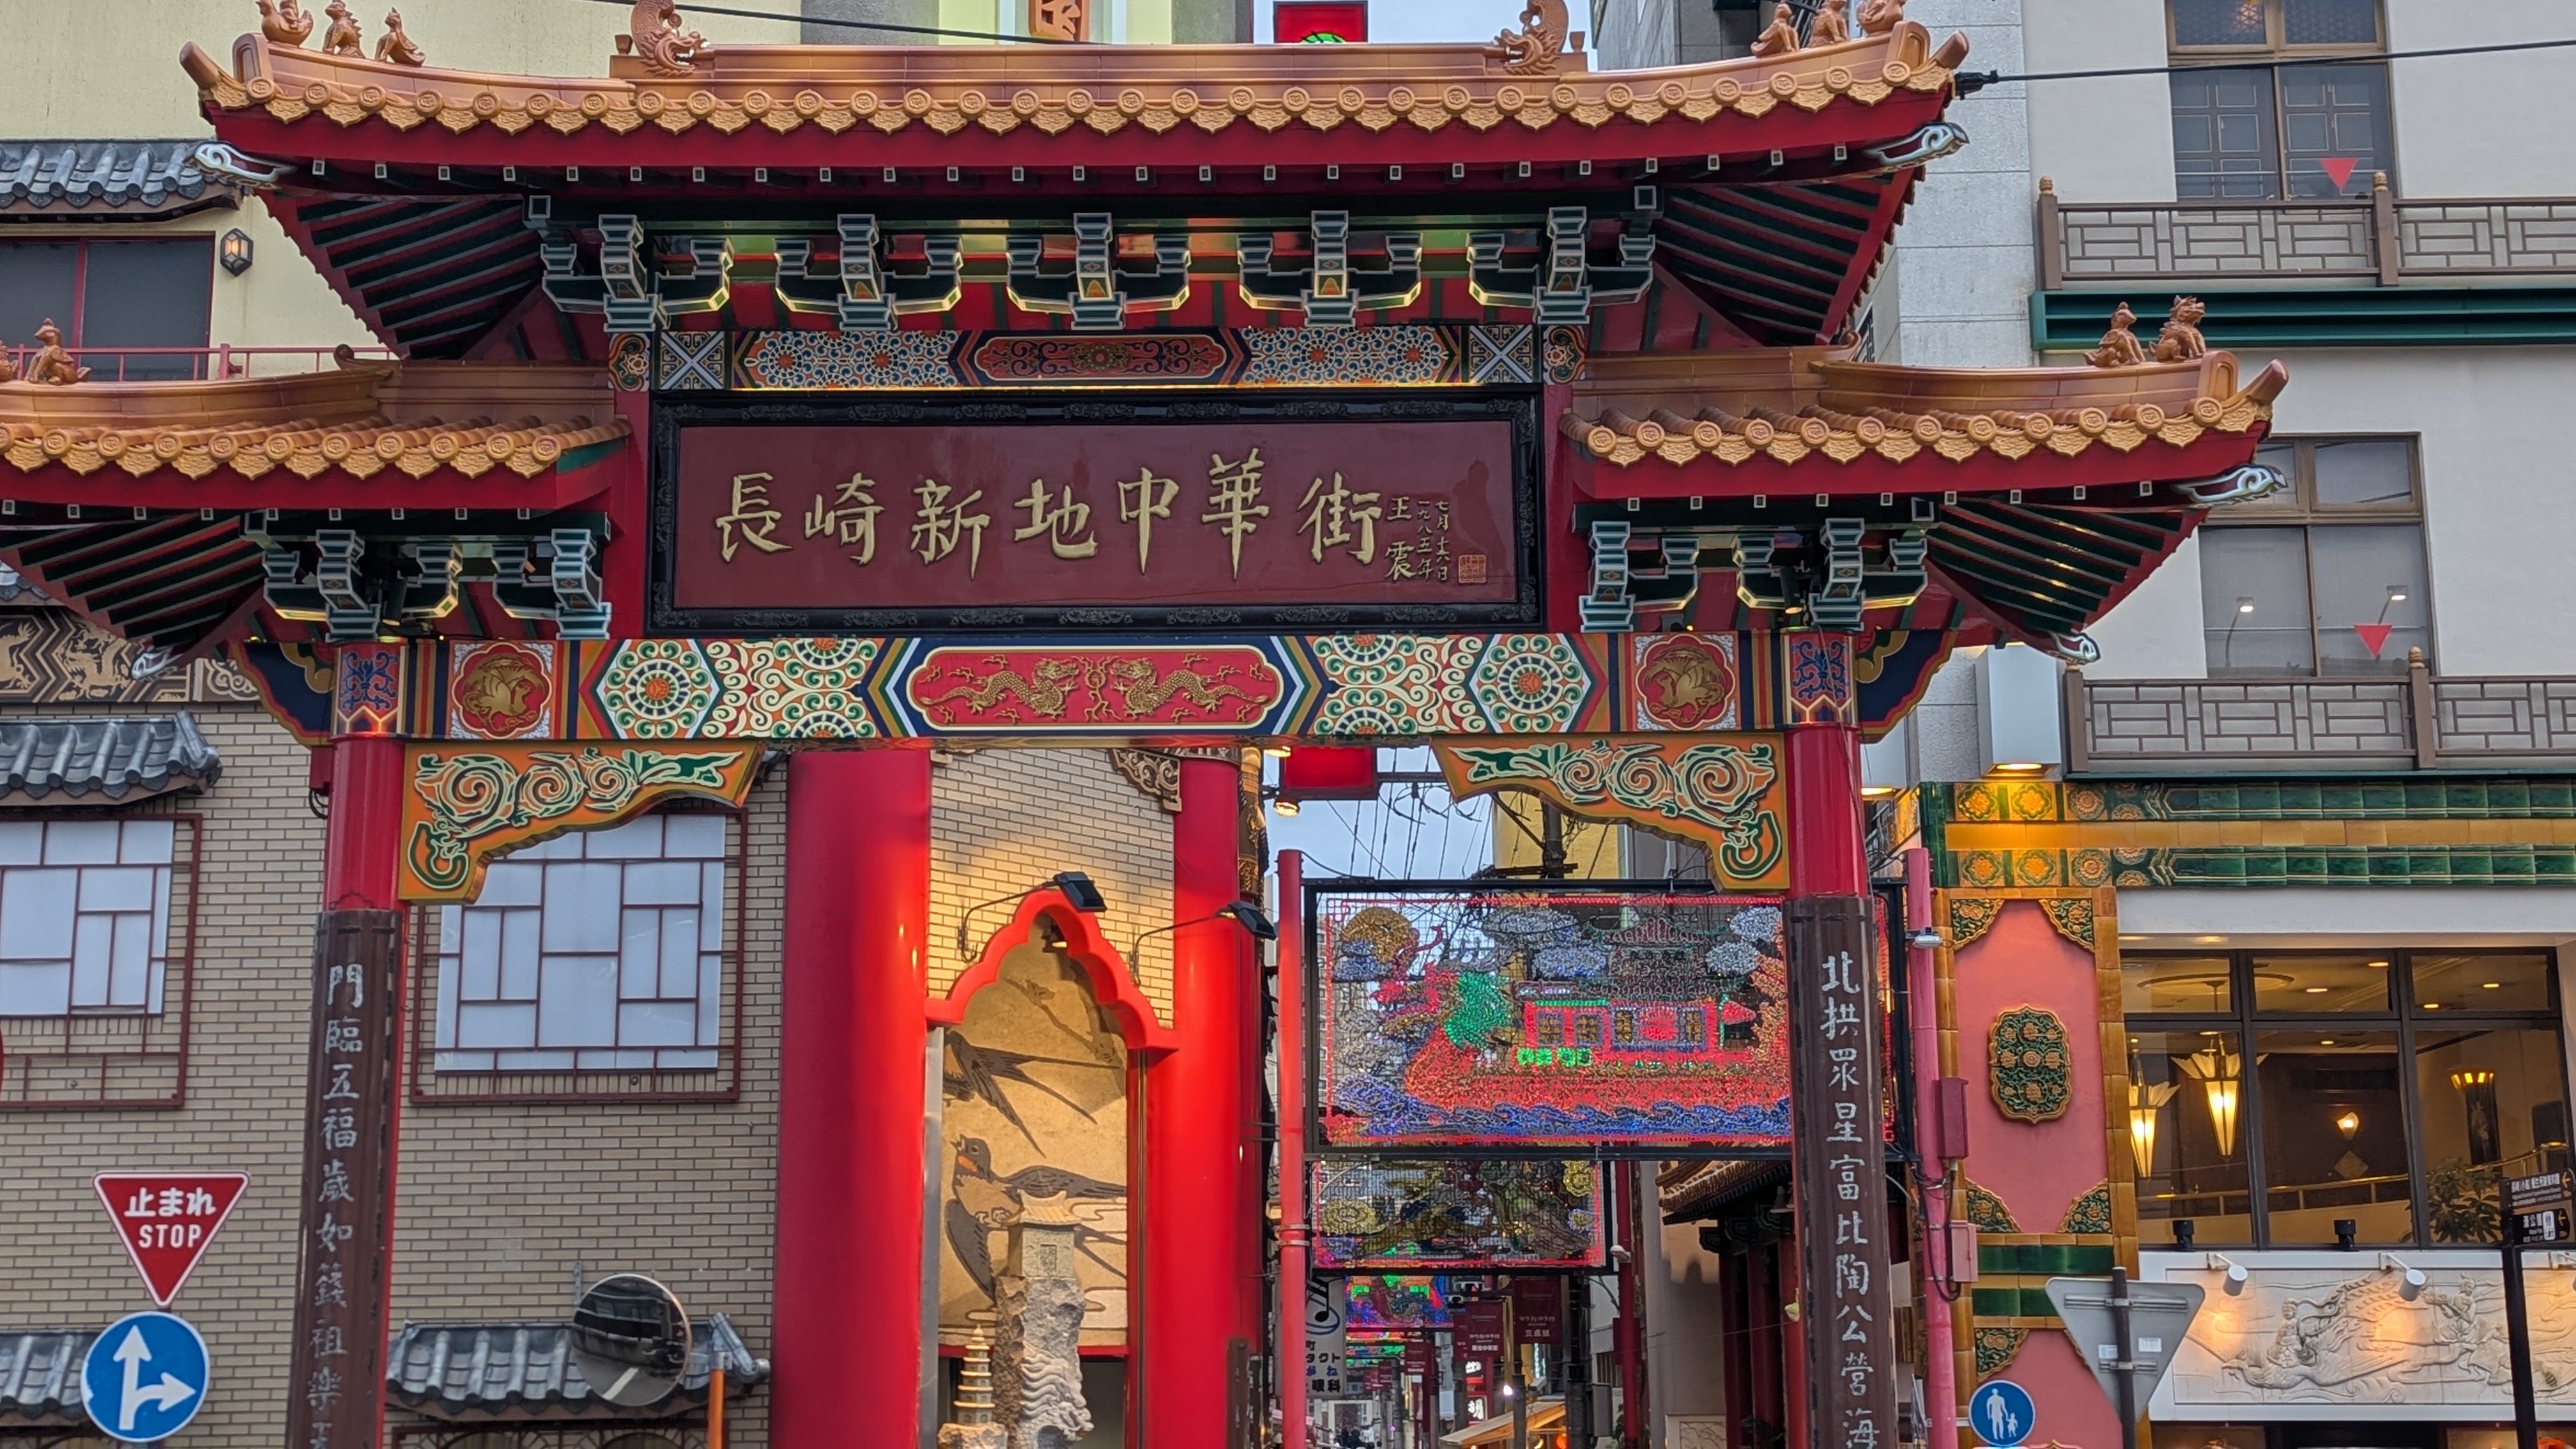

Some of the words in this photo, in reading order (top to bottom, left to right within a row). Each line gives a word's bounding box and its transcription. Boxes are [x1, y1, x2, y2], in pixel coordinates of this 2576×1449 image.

[716, 448, 1383, 580] 長崎新地中華街
[1385, 496, 1416, 581] 王震
[1416, 500, 1434, 582] 一九八五年
[123, 1186, 217, 1217] 止まれ
[138, 1224, 202, 1248] STOP
